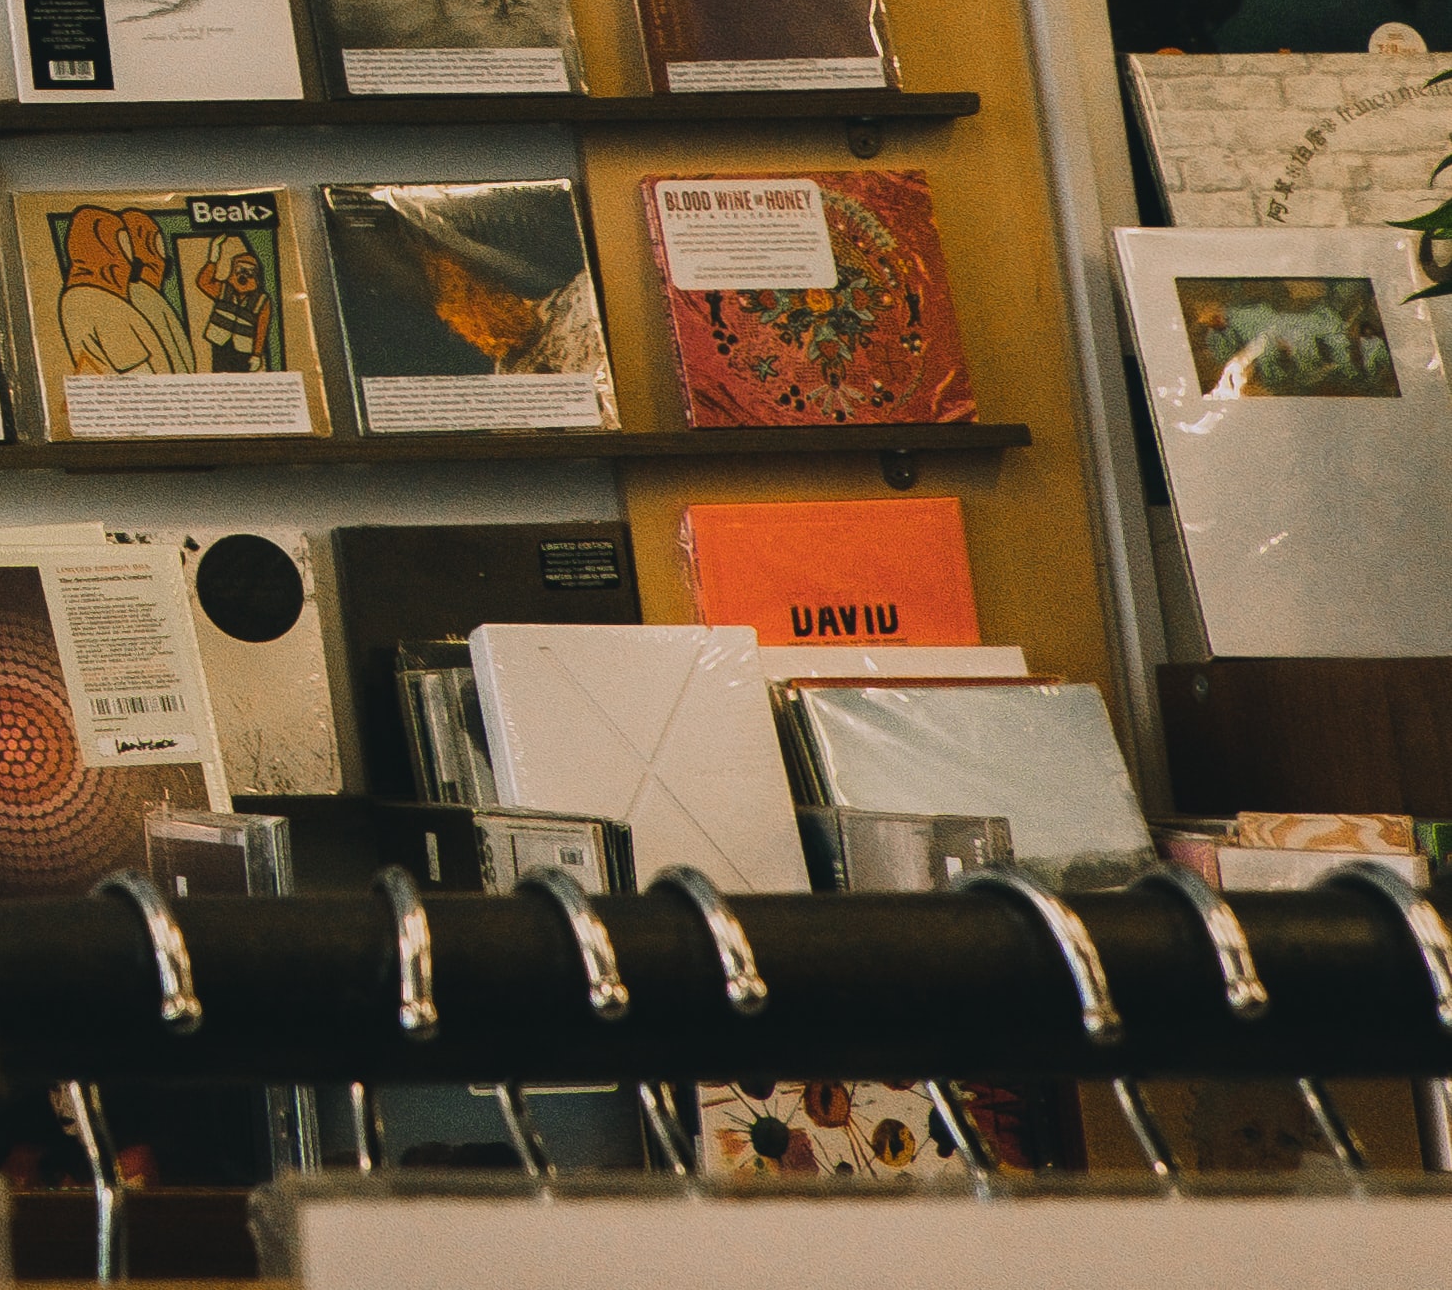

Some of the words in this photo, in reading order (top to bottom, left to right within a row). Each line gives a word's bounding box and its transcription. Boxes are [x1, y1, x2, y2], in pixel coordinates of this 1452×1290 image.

[191, 197, 275, 225] Beak>
[664, 190, 712, 211] BLOOD
[714, 190, 753, 211] WINE
[765, 190, 812, 212] HONEY
